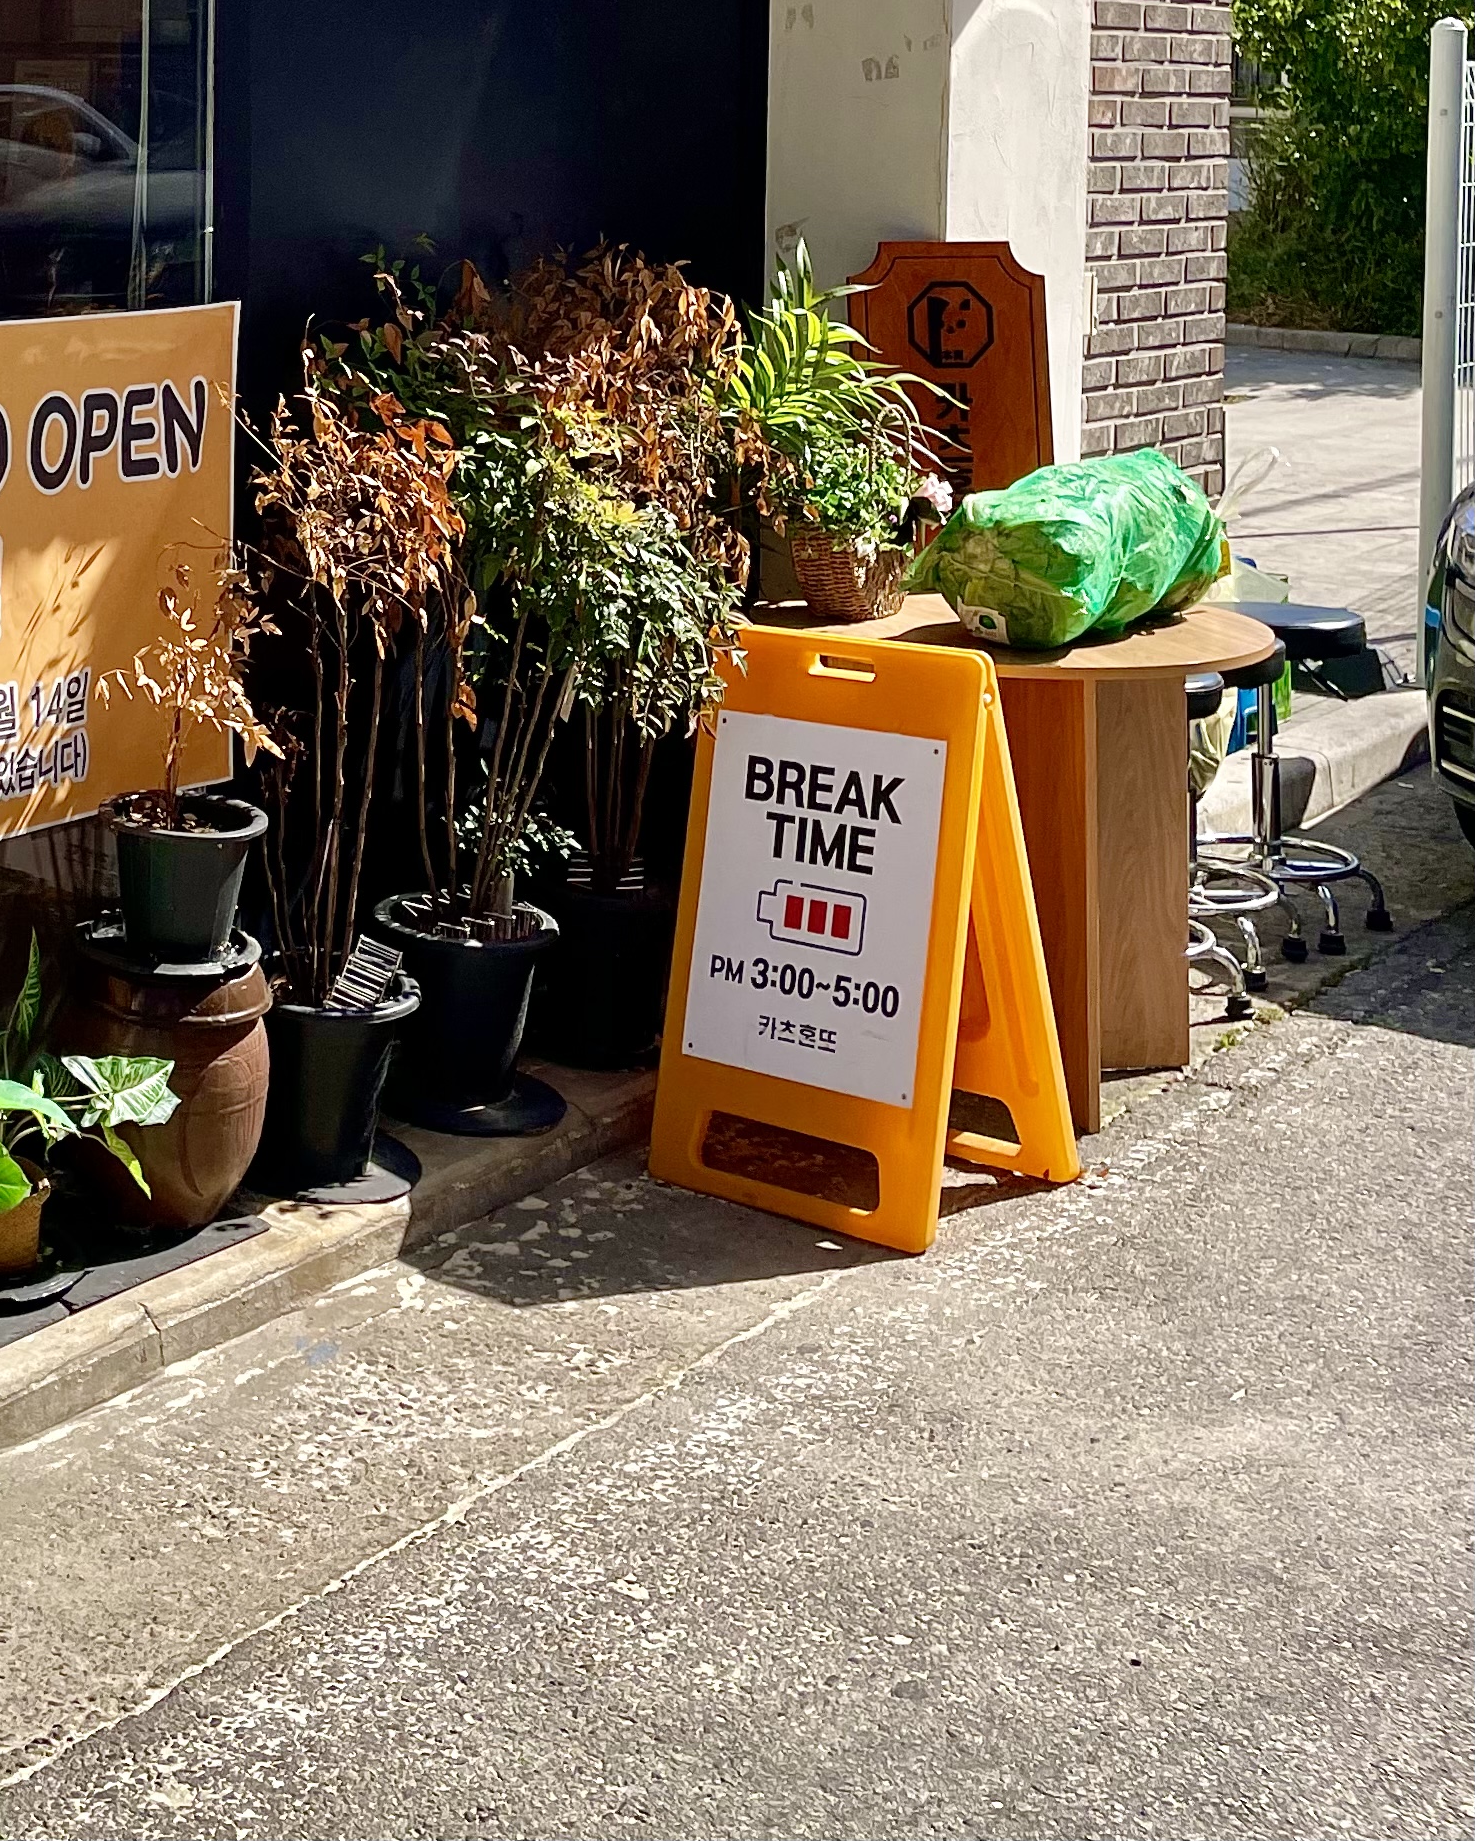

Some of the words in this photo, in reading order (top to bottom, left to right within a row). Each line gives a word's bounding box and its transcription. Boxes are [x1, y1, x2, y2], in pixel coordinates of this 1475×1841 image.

[30, 378, 208, 492] OPEN
[31, 670, 90, 729] 14일
[744, 754, 907, 825] BREAK
[765, 810, 877, 876] TIME
[709, 954, 744, 986] PM
[750, 957, 901, 1020] 3:00~5:00
[757, 1014, 839, 1054] 카츠혼또
